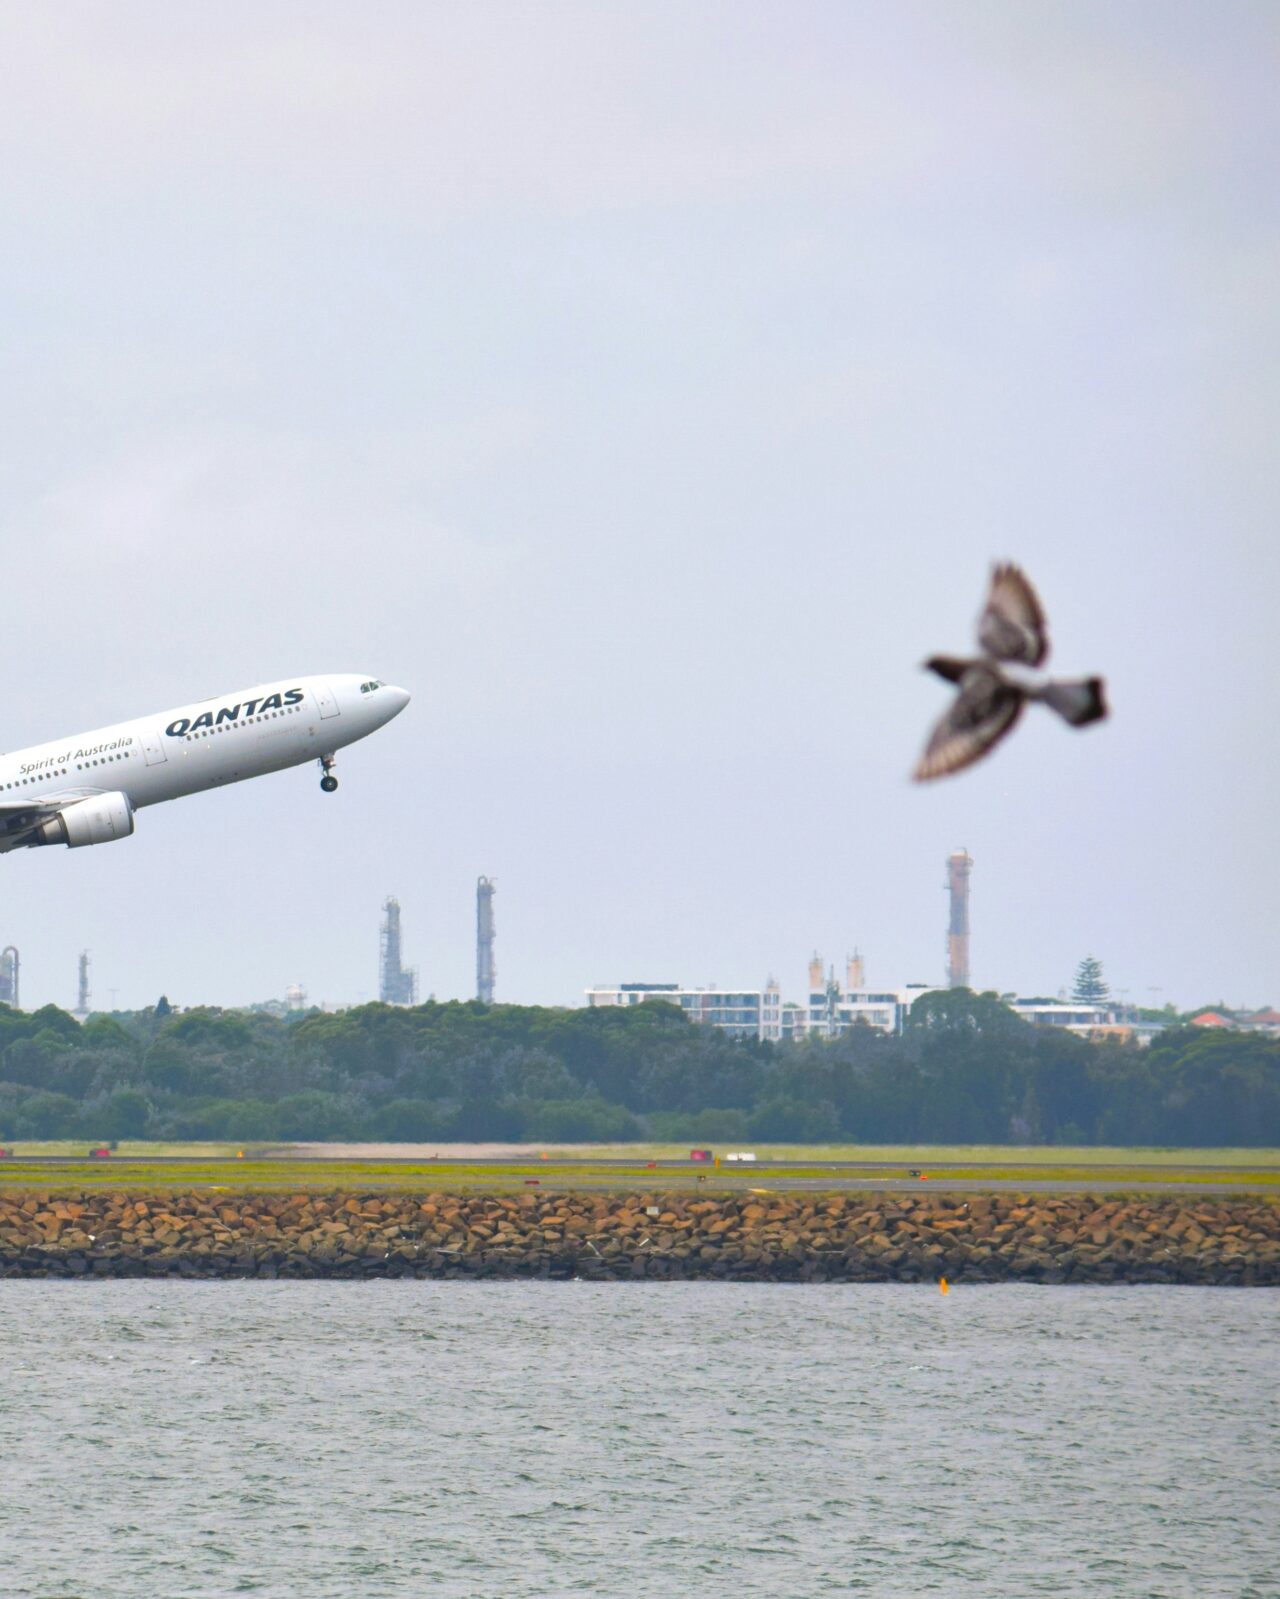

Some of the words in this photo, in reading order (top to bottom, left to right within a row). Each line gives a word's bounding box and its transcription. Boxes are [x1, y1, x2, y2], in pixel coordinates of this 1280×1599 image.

[165, 687, 305, 738] QANTAS
[19, 756, 55, 775] Spirit
[57, 751, 72, 764] of
[73, 737, 133, 760] Australia
